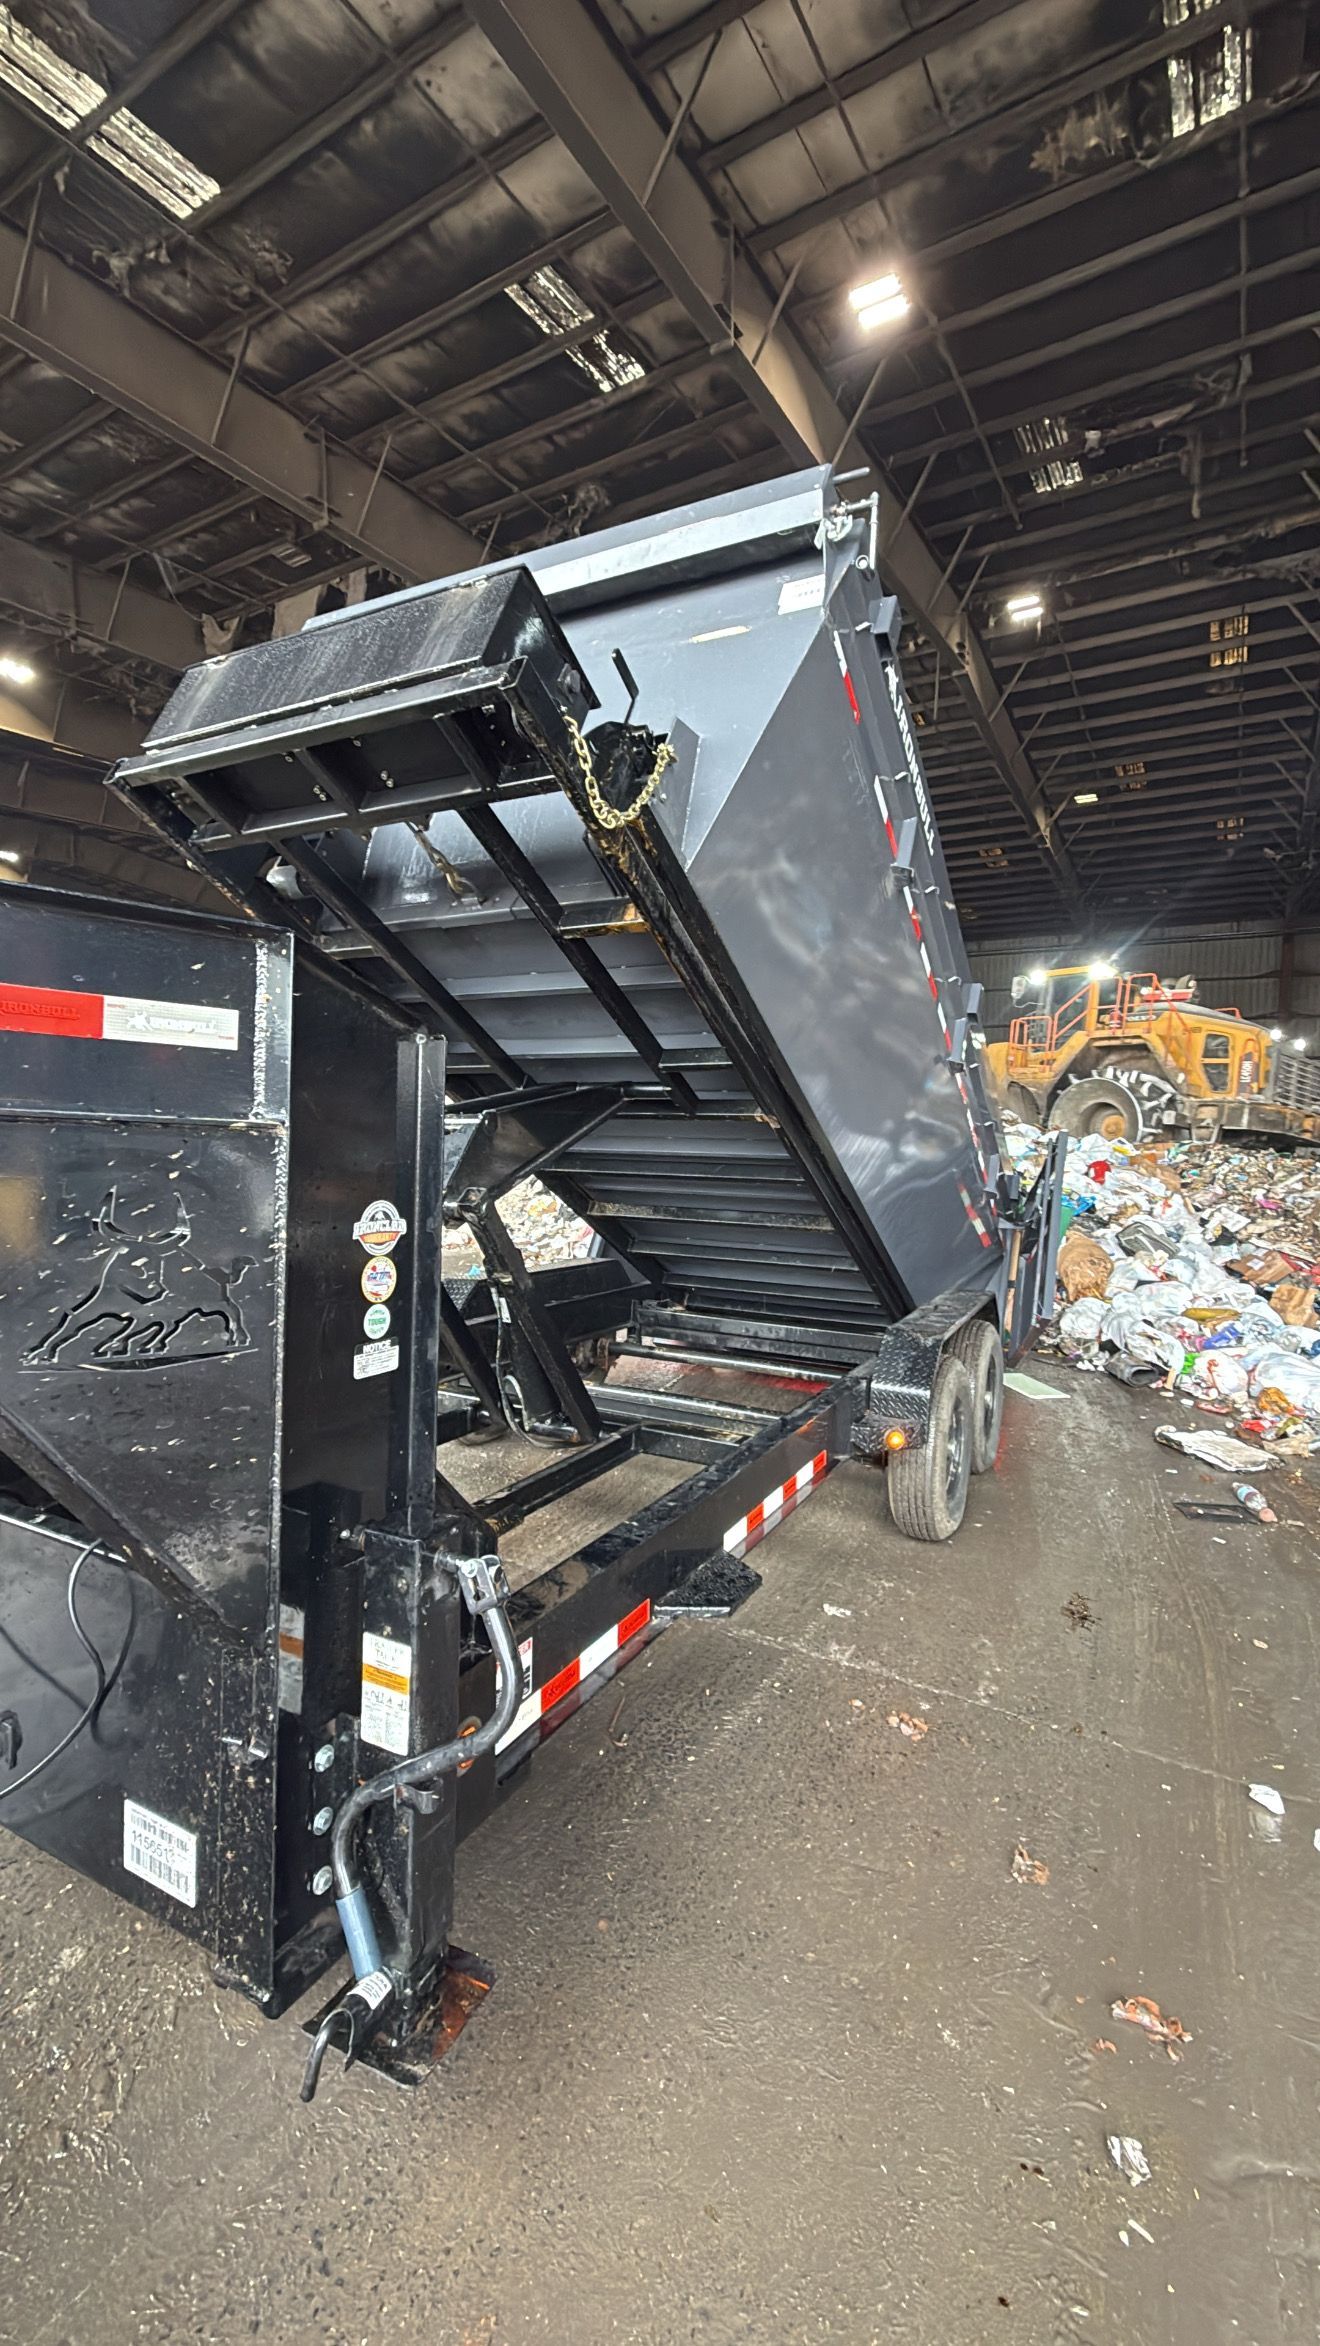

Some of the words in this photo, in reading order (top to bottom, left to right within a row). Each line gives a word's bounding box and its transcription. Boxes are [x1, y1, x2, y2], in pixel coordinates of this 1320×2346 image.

[892, 693, 935, 857] IRONBULL
[1, 1000, 81, 1021] IRONBULL
[363, 1340, 393, 1355] NOTICE
